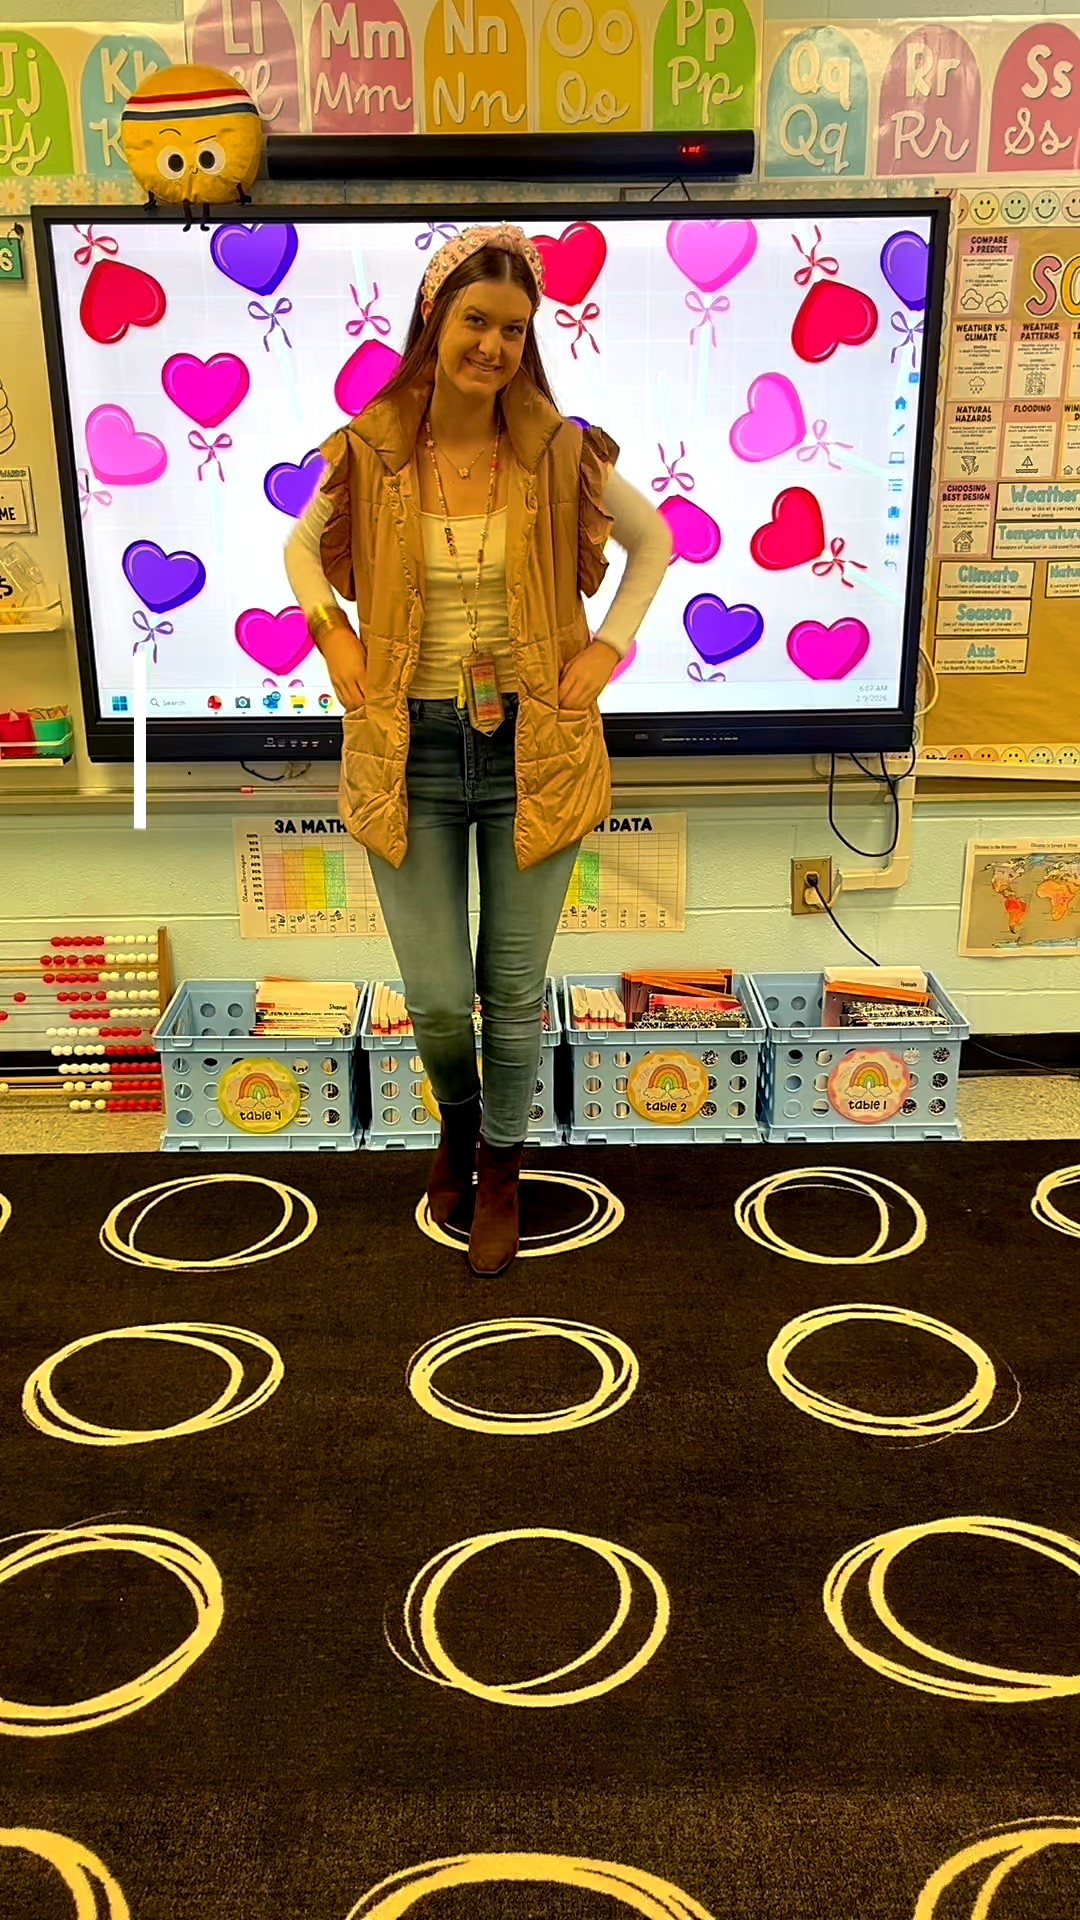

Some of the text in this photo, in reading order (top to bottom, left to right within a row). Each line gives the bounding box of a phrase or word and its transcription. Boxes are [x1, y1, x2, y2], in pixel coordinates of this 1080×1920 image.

[321, 2, 406, 59] Mm
[443, 0, 507, 55] Nn
[549, 0, 634, 58] Oo
[675, 0, 734, 62] Pp
[788, 41, 851, 111] Qq
[905, 43, 961, 98] Rr
[1021, 44, 1074, 99] Ss
[313, 71, 413, 115] Mm
[556, 70, 631, 125] Oo
[667, 55, 744, 125] Pp
[432, 71, 527, 127] Nn
[779, 103, 850, 174] Qq
[891, 109, 970, 161] Rr
[1004, 107, 1073, 155] Ss
[971, 235, 1009, 244] COMPARE
[976, 245, 1008, 254] PREDICT
[956, 323, 1008, 332] WEATHER VS.
[1022, 322, 1060, 331] WEATHER
[964, 332, 998, 341] CLIMATE
[1020, 331, 1060, 340] PATTERNS
[956, 405, 993, 413] NATURAL
[1013, 404, 1052, 413] FLOODING
[955, 414, 992, 422] HAZARDS
[946, 484, 987, 492] CHOOSING
[1011, 484, 1080, 503] Weather
[942, 493, 990, 501] BEST DESIGN
[958, 565, 1019, 583] Climate
[956, 603, 1012, 621] Season
[966, 642, 996, 658] Axis
[274, 819, 297, 833] 3A
[609, 817, 653, 832] DATA
[645, 1101, 687, 1112] table 2
[848, 1100, 887, 1110] table 1
[239, 1110, 281, 1120] table 4
